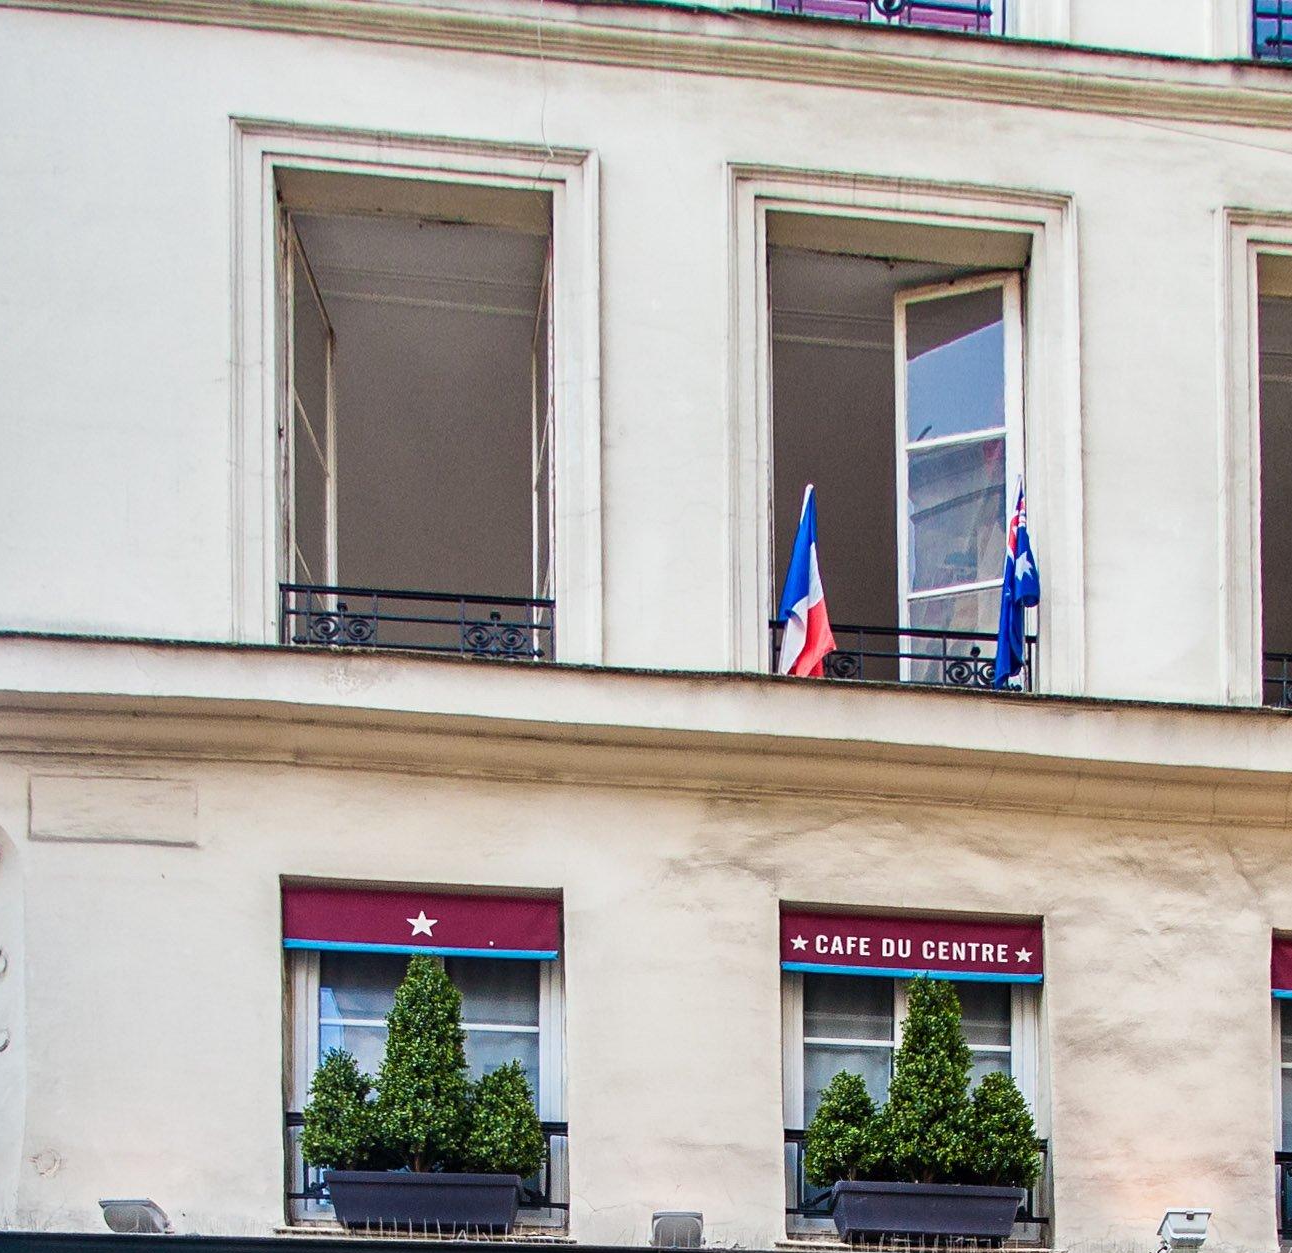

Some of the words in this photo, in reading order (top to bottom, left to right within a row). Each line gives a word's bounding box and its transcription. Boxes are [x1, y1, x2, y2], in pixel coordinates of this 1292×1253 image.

[815, 935, 871, 956] CAFE
[882, 938, 911, 958] DU
[922, 941, 1009, 963] CENTRE
